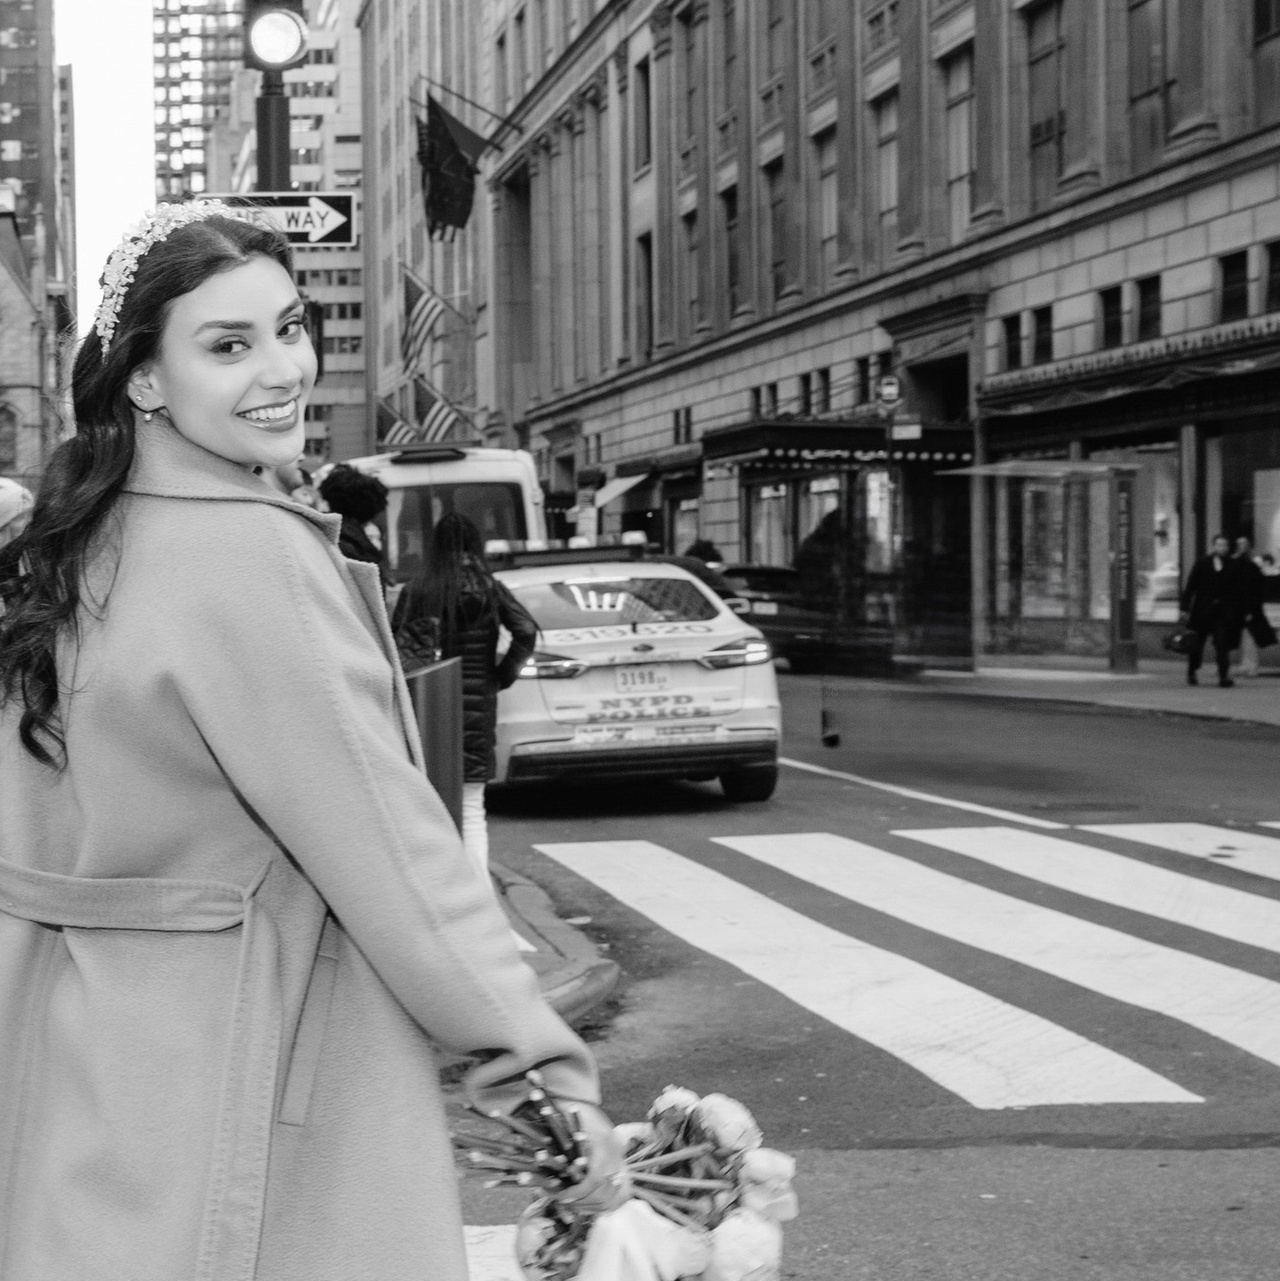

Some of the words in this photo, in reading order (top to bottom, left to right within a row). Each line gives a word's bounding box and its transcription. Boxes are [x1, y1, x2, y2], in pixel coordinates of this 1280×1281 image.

[285, 211, 330, 229] WAY
[620, 670, 655, 686] 3198
[600, 694, 694, 710] NYPD
[587, 706, 711, 723] POLICE
